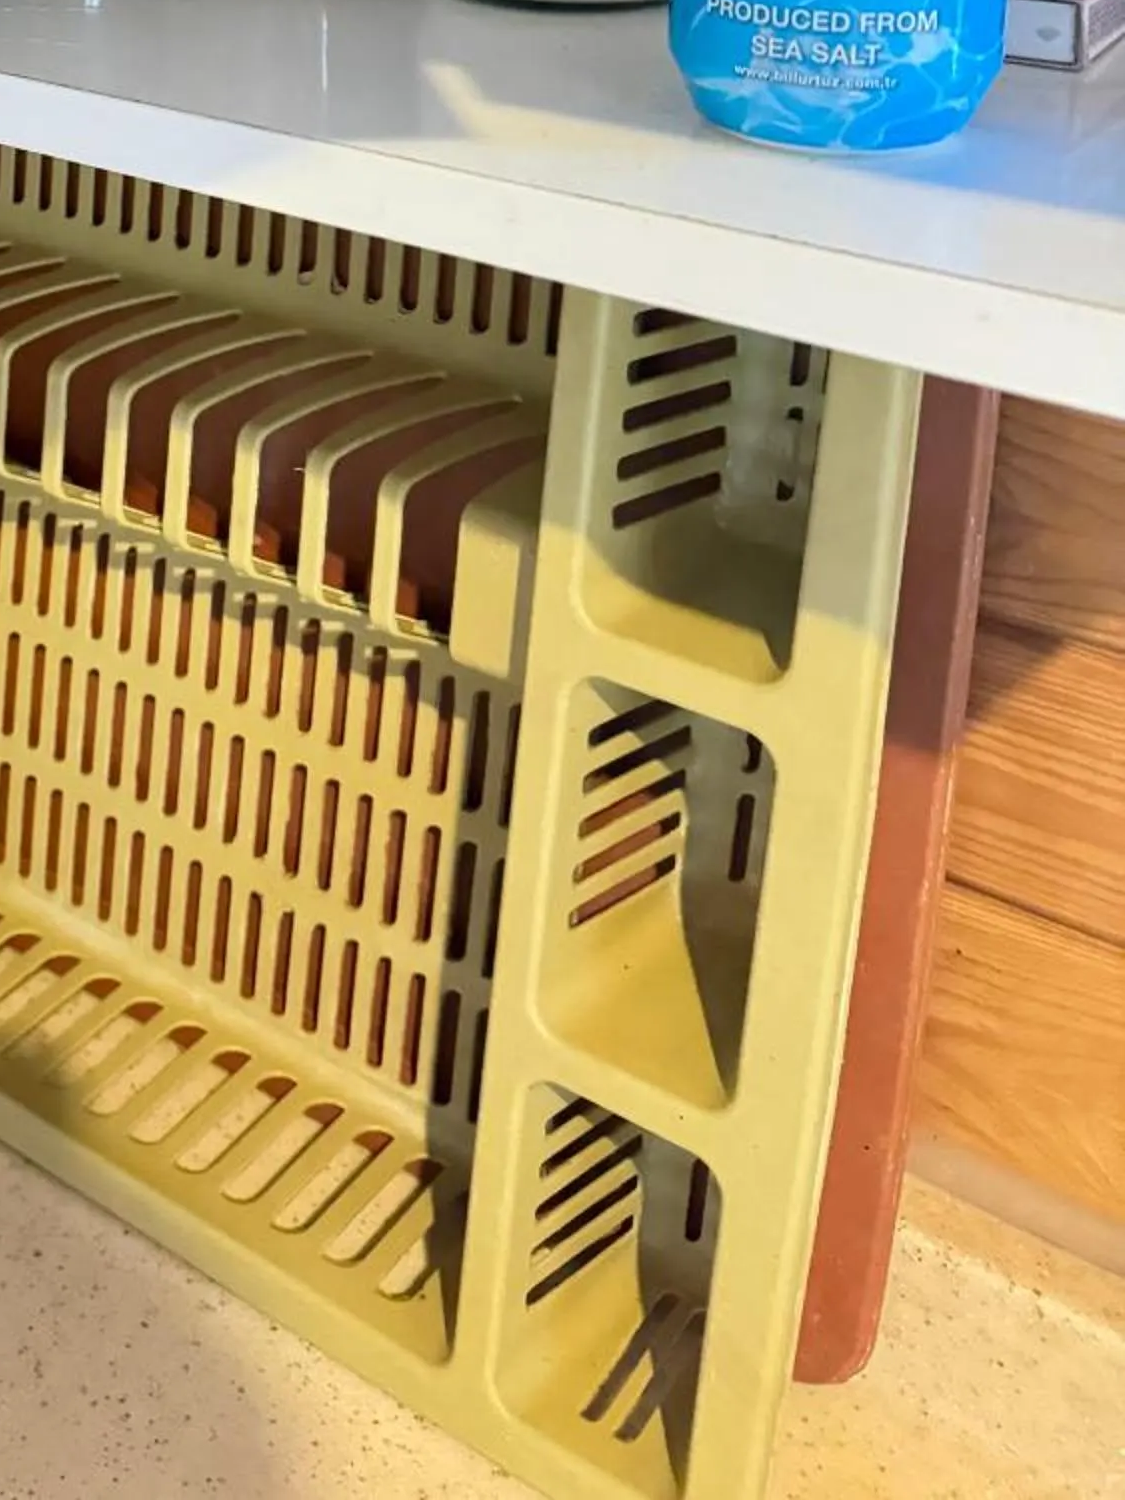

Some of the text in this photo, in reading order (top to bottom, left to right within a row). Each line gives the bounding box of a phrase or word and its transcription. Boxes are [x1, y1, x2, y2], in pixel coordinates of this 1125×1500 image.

[859, 9, 939, 34] FROM
[751, 34, 882, 67] SEA SALT
